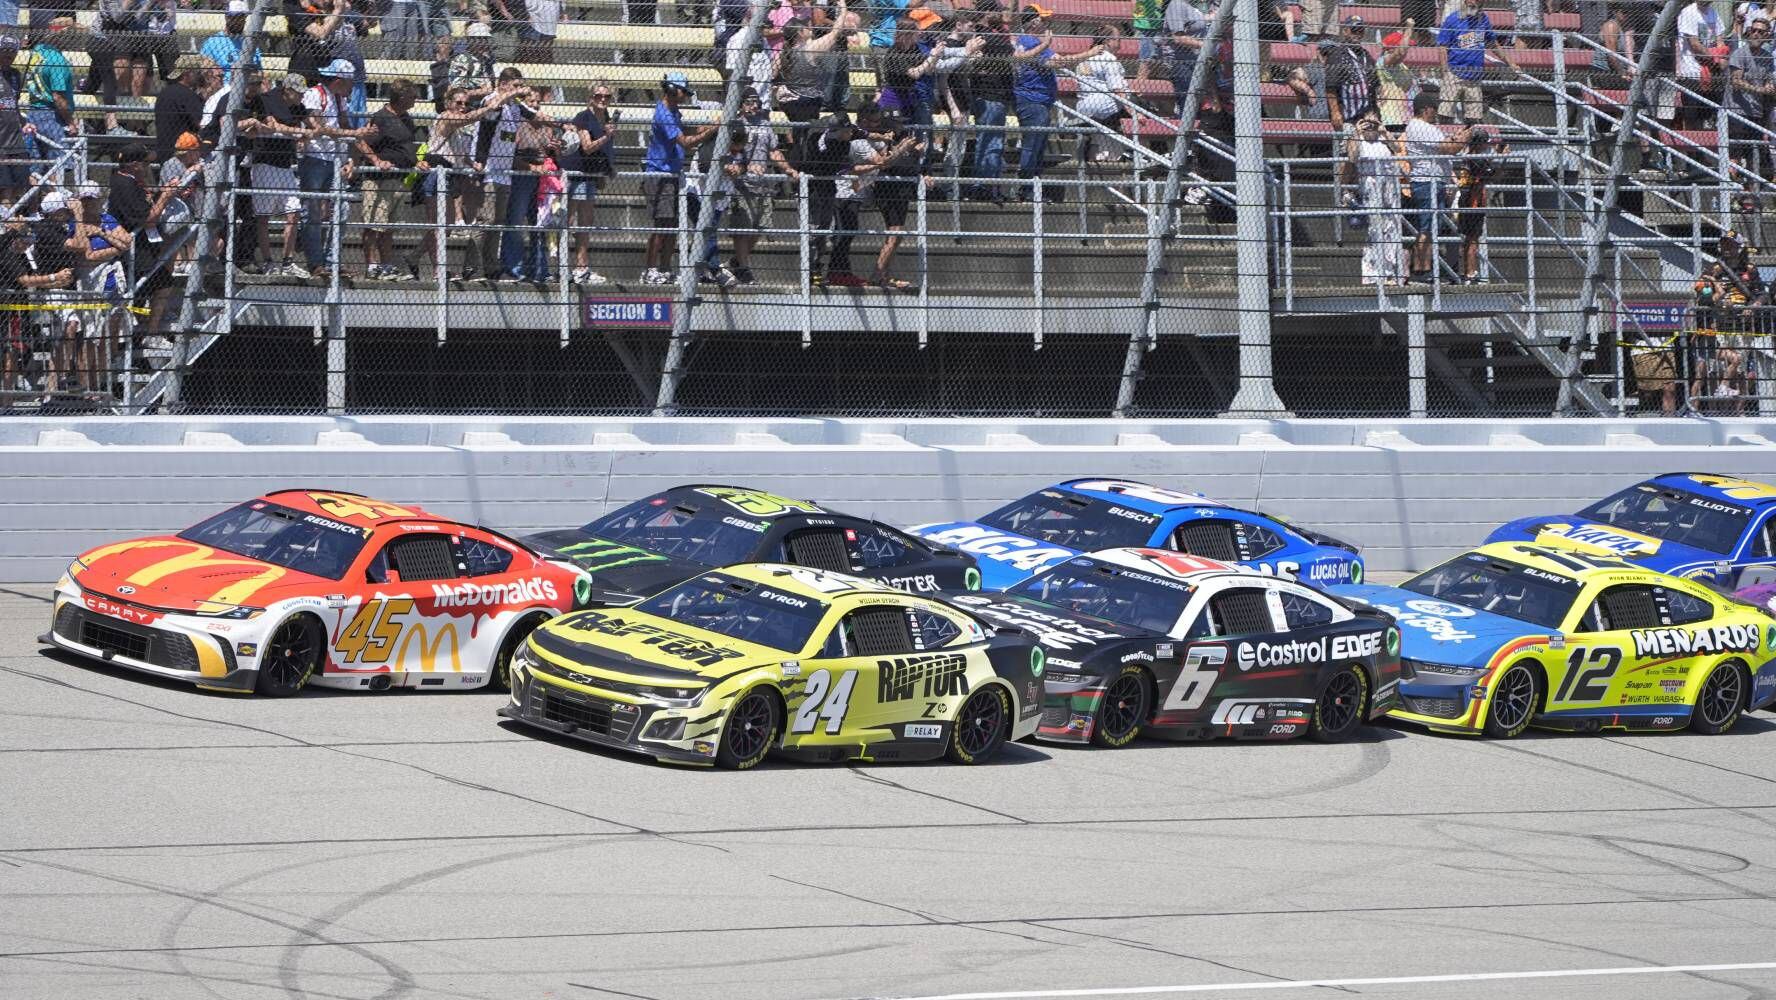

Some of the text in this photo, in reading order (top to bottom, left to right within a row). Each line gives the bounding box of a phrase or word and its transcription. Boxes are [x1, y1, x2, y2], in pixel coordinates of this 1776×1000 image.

[589, 303, 662, 320] SECTION 6
[1107, 505, 1155, 524] BUSCH
[1689, 498, 1742, 516] ELLIOTT
[303, 514, 360, 535] REDDICK
[722, 515, 765, 533] GIBBS
[1553, 525, 1646, 554] NAPA
[1119, 569, 1190, 592] KESELOWSKI
[1310, 562, 1350, 580] LUCAS OIL
[1522, 567, 1572, 585] BLANEY
[431, 576, 558, 608] McDonald's
[758, 590, 808, 609] BYRON
[86, 599, 149, 621] CAMRY
[334, 598, 416, 664] 45
[1256, 630, 1384, 668] Castrol EDGE
[1631, 623, 1760, 660] MENARDS
[1046, 656, 1084, 669] EDGE
[1120, 650, 1155, 664] GOODYEAR
[876, 652, 970, 704] RAPTOR
[1162, 646, 1228, 711] 6
[1557, 645, 1623, 703] 12
[1624, 680, 1653, 691] Snap-on
[791, 668, 859, 736] 24
[1653, 695, 1686, 704] WABASH
[1269, 724, 1296, 735] FORD
[1652, 717, 1674, 725] FORD
[913, 726, 940, 736] RELAY
